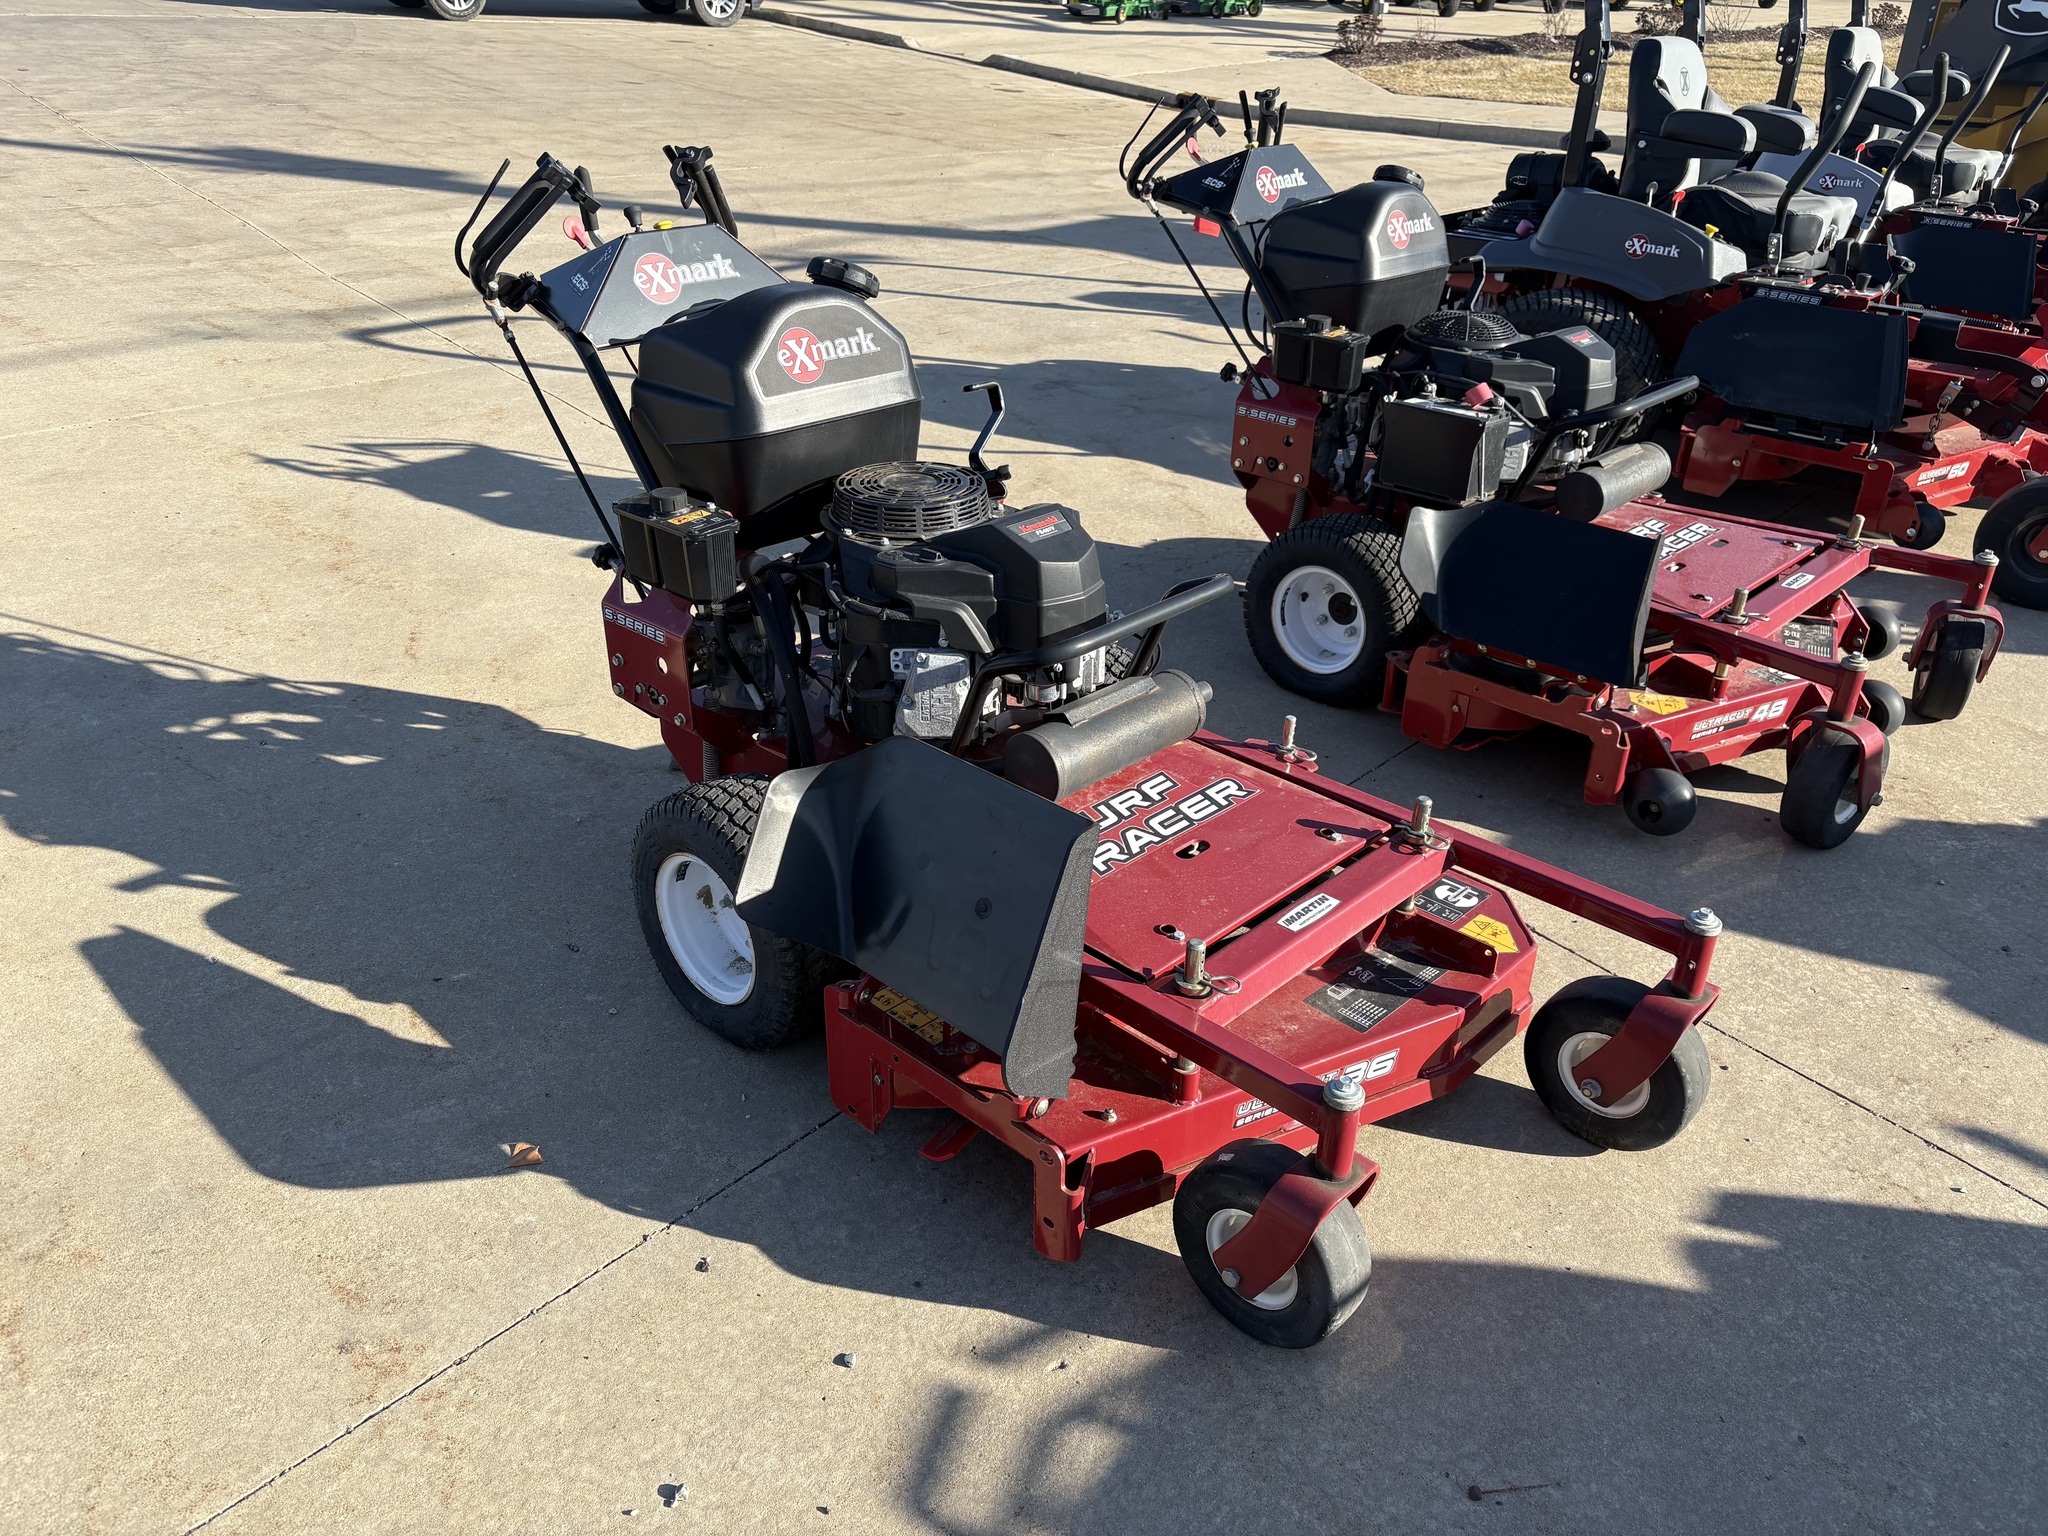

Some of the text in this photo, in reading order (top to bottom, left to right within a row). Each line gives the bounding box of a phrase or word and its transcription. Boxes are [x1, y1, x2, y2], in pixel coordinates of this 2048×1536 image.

[1203, 177, 1224, 189] ECS
[1256, 168, 1307, 196] eXmark
[1819, 175, 1863, 188] eXmark
[1387, 212, 1434, 242] eXmark
[1624, 237, 1680, 258] eXmark
[572, 273, 588, 291] ECS
[634, 253, 739, 296] eXmark
[777, 327, 880, 375] eXmark
[1948, 461, 1970, 479] 60
[1692, 698, 1789, 731] ULTRACUT 48
[1283, 895, 1330, 926] MARTIN
